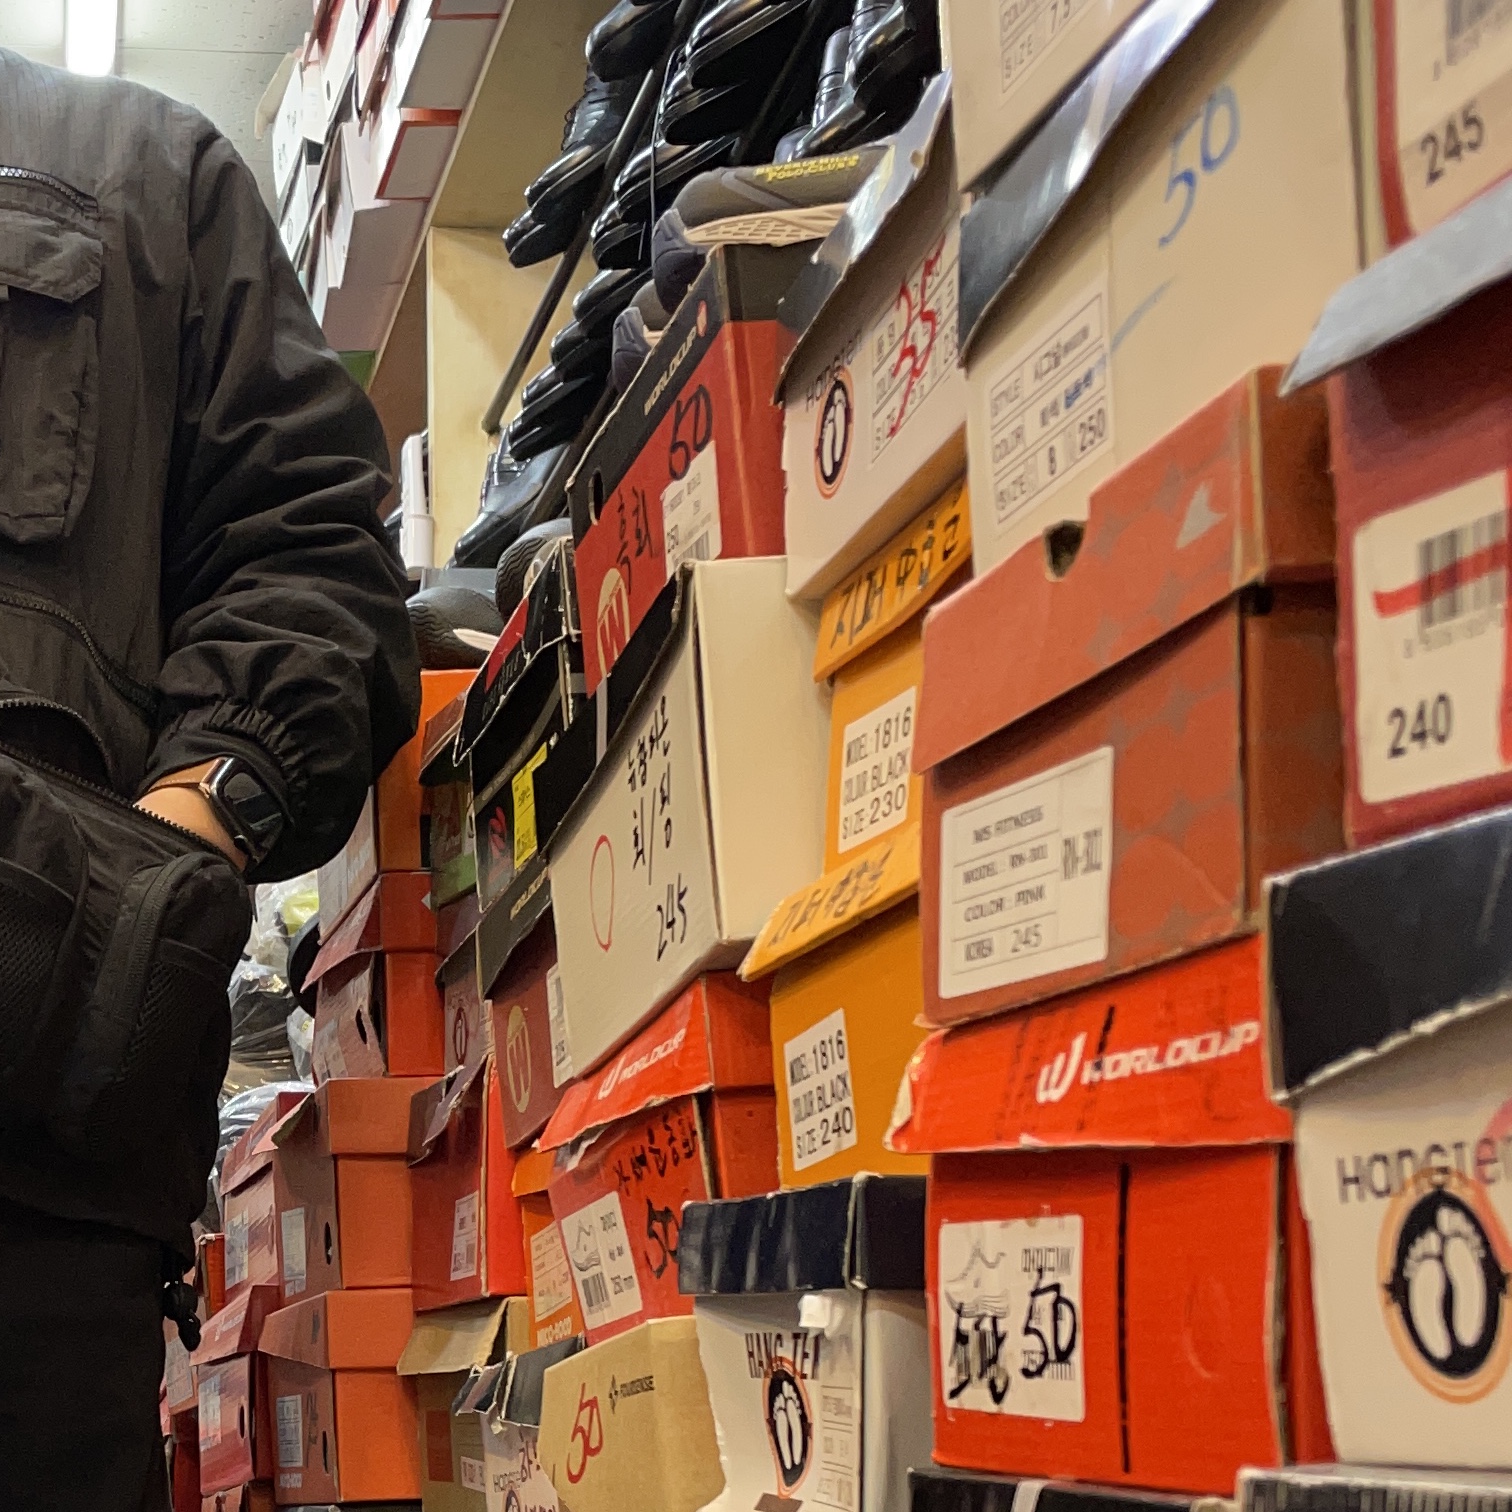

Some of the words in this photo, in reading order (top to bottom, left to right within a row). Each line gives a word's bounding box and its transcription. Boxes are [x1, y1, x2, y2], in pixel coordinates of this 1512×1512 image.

[1156, 84, 1241, 250] 50
[1420, 100, 1486, 188] 245
[1078, 407, 1107, 452] 250
[874, 706, 912, 755] 1816
[1387, 692, 1454, 759] 240
[870, 783, 907, 826] 230
[656, 872, 688, 962] 245
[1011, 924, 1043, 953] 245
[813, 1029, 845, 1075] 1816
[1080, 1020, 1261, 1085] WORLDCUP
[820, 1106, 854, 1146] 240
[745, 1332, 785, 1379] HANG
[566, 1382, 604, 1484] 50
